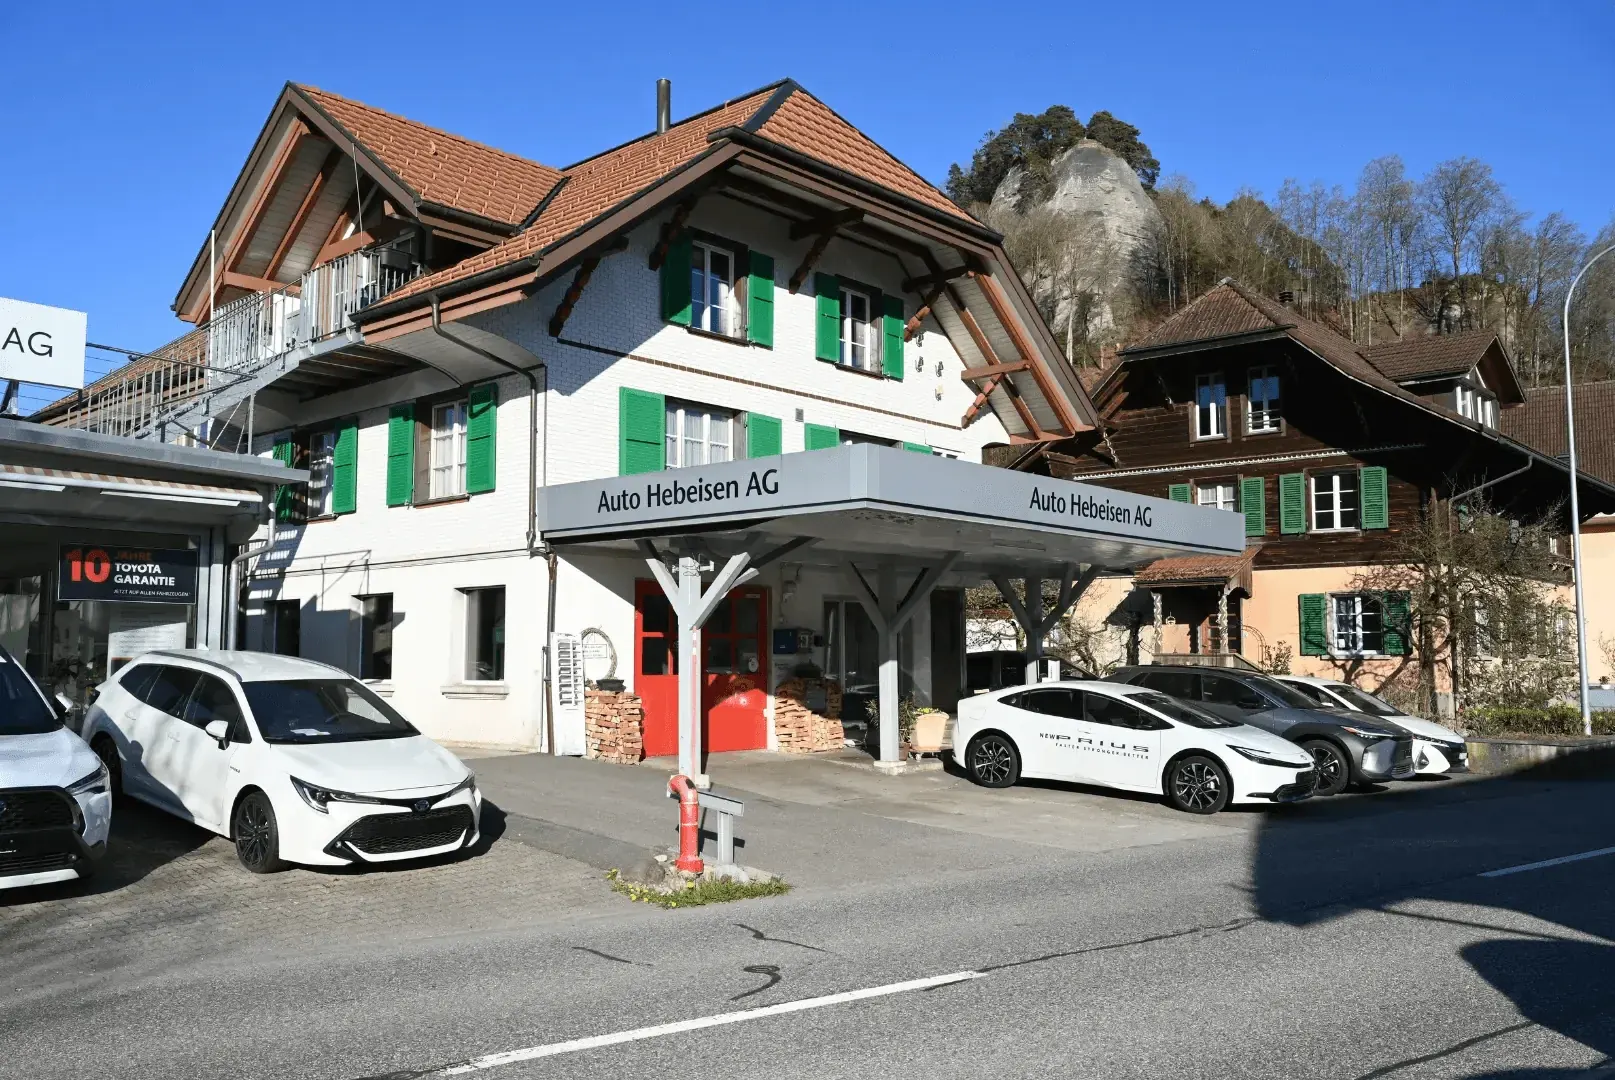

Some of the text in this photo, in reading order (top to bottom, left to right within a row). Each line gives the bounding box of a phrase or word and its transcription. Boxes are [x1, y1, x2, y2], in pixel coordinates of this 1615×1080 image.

[1, 327, 53, 358] AG
[597, 468, 779, 513] Auto Hebeisen AG
[1029, 486, 1152, 528] Auto Hebeisen AG
[65, 548, 111, 583] 10
[113, 574, 176, 586] GARANTIE
[114, 562, 162, 574] TOYOTA
[1039, 732, 1149, 752] NEW PRIUS
